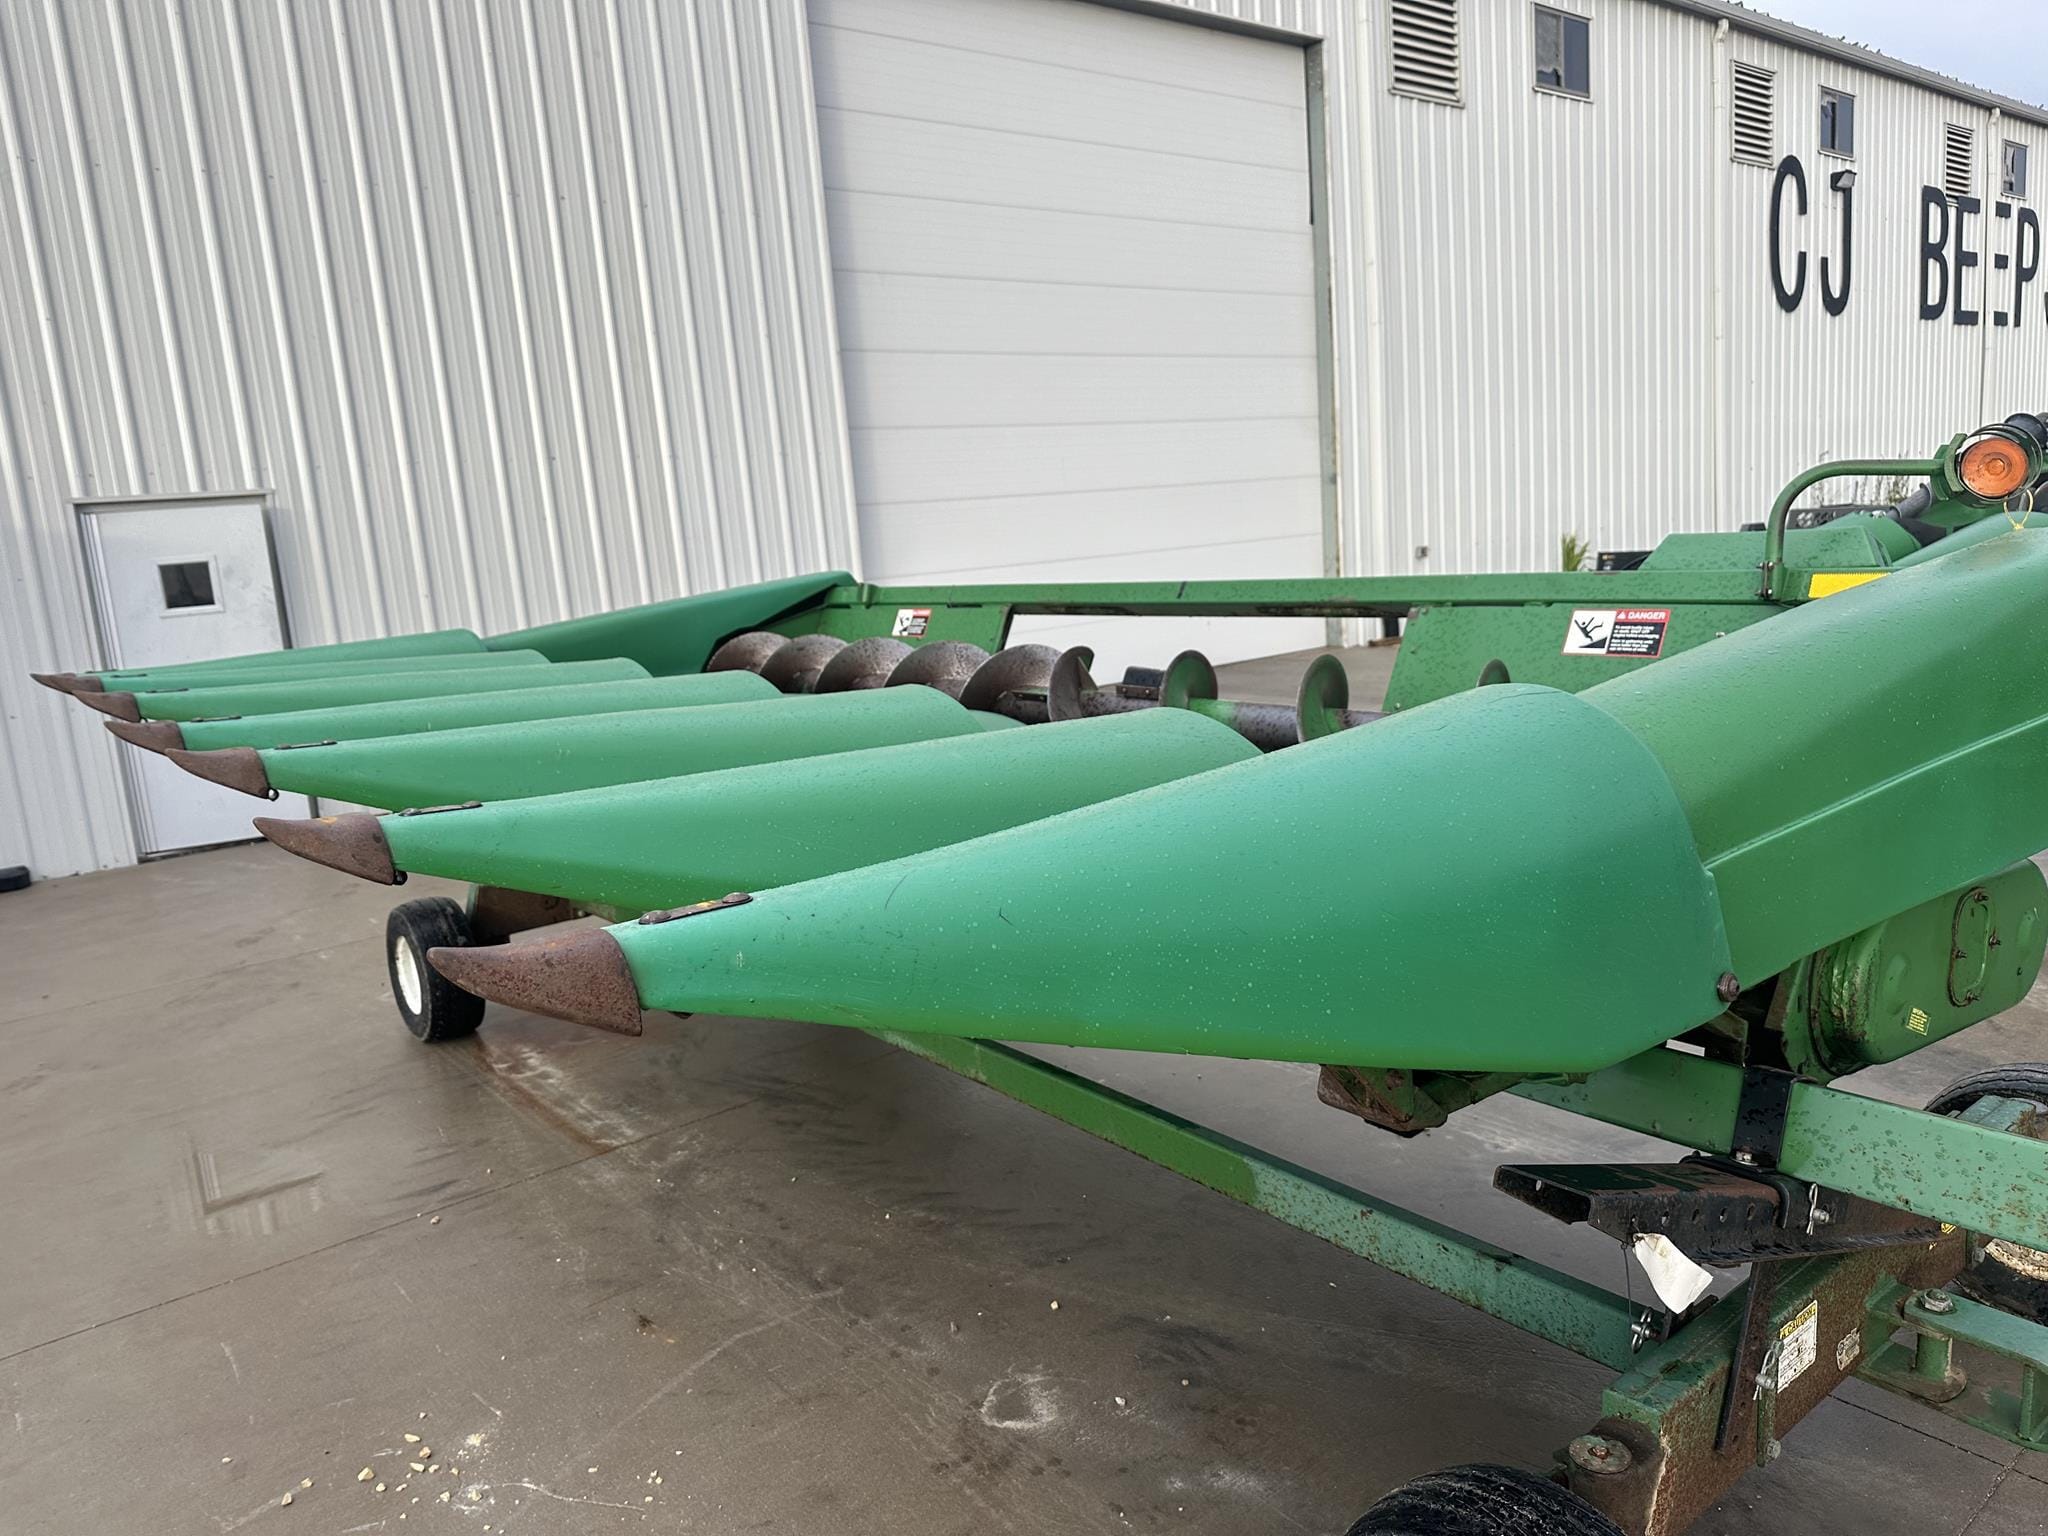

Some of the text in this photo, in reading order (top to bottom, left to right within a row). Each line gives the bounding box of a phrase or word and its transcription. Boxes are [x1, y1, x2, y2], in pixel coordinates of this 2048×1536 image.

[1770, 154, 2048, 328] CJ BEEP
[1627, 611, 1666, 620] DANGER
